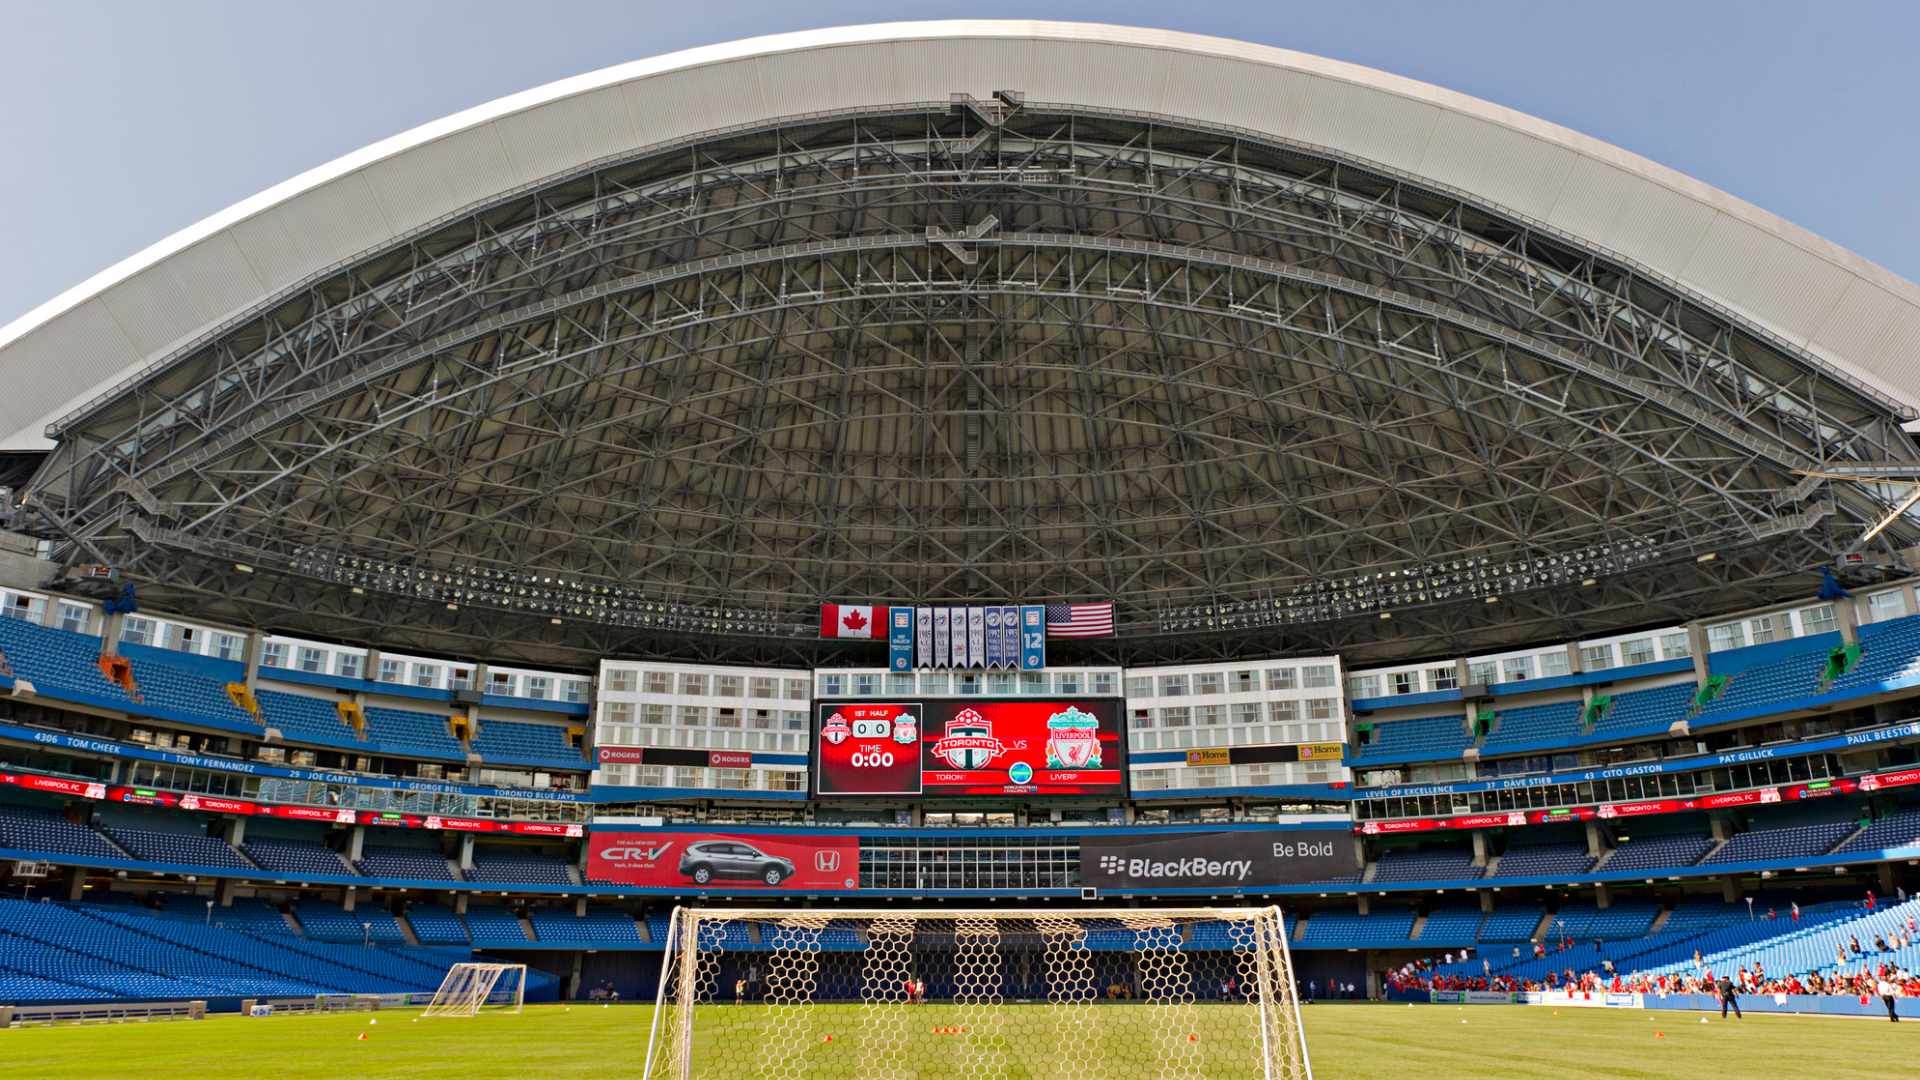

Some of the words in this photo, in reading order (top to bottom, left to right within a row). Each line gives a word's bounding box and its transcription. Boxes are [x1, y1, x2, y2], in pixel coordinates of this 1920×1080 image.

[1023, 633, 1042, 649] 12
[858, 724, 867, 734] 0
[876, 724, 885, 734] 0
[1847, 735, 1872, 744] PAUL
[1874, 725, 1920, 740] BEESTON
[34, 732, 58, 744] 4306
[67, 737, 89, 749] TOM
[91, 742, 120, 753] CHEEK
[859, 744, 882, 752] TIME
[943, 739, 995, 748] TORONTO
[1013, 741, 1028, 749] VS
[1201, 751, 1228, 759] Home
[1314, 745, 1341, 754] Home
[851, 752, 894, 767] 0:00
[1719, 754, 1736, 763] PAT
[1739, 750, 1774, 762] GILLICK
[176, 755, 201, 765] TONY
[203, 759, 255, 773] FERNANDEZ
[288, 770, 300, 778] 29
[307, 772, 322, 780] JOE
[326, 774, 358, 784] CARTER
[1584, 772, 1594, 780] 43
[1602, 767, 1623, 778] CITO
[1625, 763, 1663, 775] GASTON
[1503, 778, 1526, 788] DAVE
[1529, 776, 1552, 786] STIEB
[1885, 773, 1917, 784] TORONTO
[34, 779, 69, 790] LIVERPOOL
[409, 782, 443, 792] GEORGE
[445, 784, 463, 793] BELL
[494, 789, 533, 799] TORONTO
[535, 791, 555, 800] BLUE
[557, 792, 576, 800] JAYS
[1365, 790, 1389, 798] LEVEL
[1391, 788, 1401, 796] OF
[1404, 785, 1454, 795] EXCELLENCE
[1711, 795, 1743, 805] LIVERPOOL
[205, 801, 233, 809] TORONTO
[288, 809, 321, 817] LIVERPOOL
[1622, 804, 1650, 812] TORONTO
[447, 820, 472, 828] TORONTO
[1463, 817, 1493, 825] LIVERPOOL
[600, 841, 674, 860] CR-V
[1273, 843, 1294, 857] Be
[1297, 842, 1333, 857] Bold
[1128, 857, 1252, 881] BlackBerry
